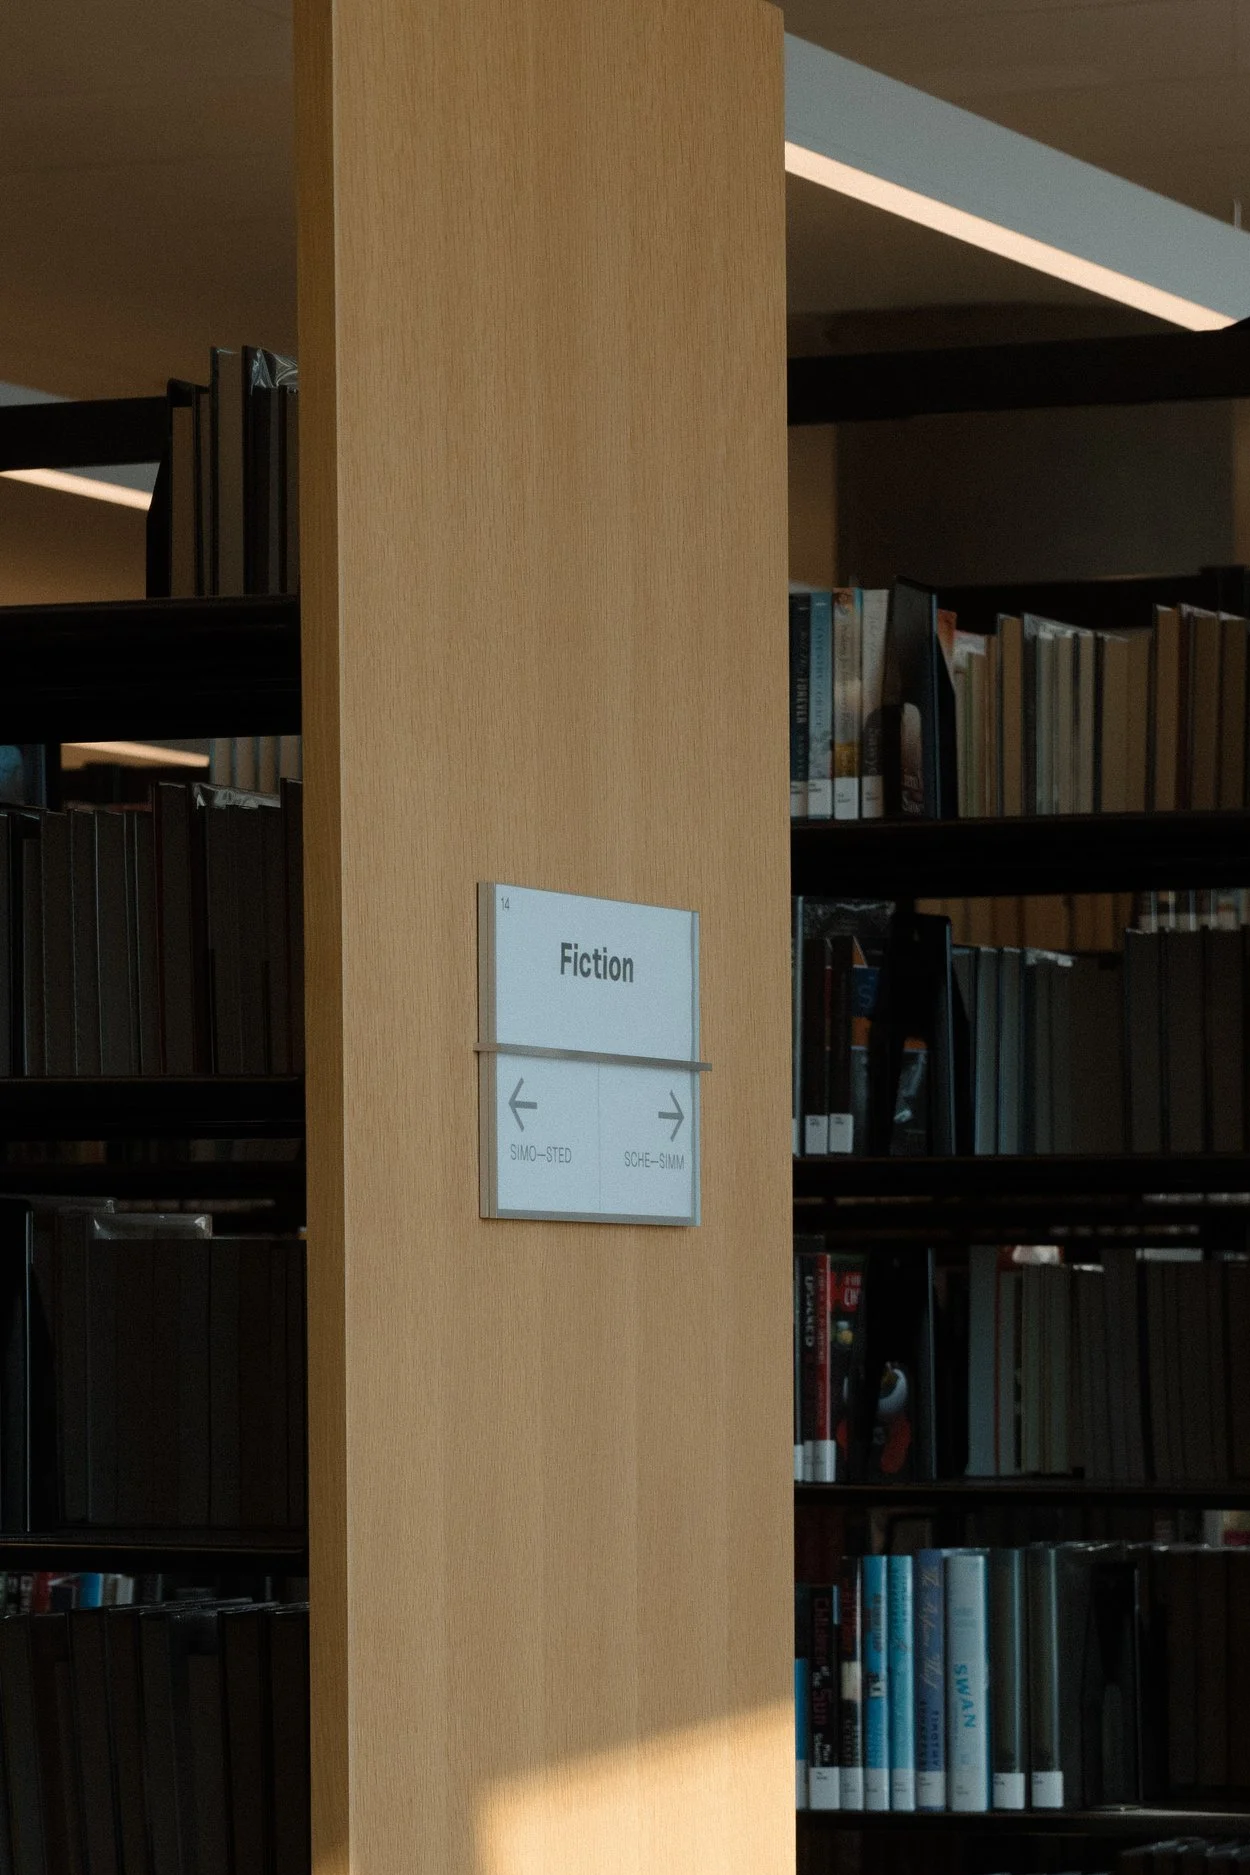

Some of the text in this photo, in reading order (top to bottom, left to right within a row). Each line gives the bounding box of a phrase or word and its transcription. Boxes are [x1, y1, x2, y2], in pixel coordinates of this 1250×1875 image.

[500, 896, 510, 912] 14
[560, 941, 634, 984] Fiction
[954, 1663, 978, 1729] SWAN
